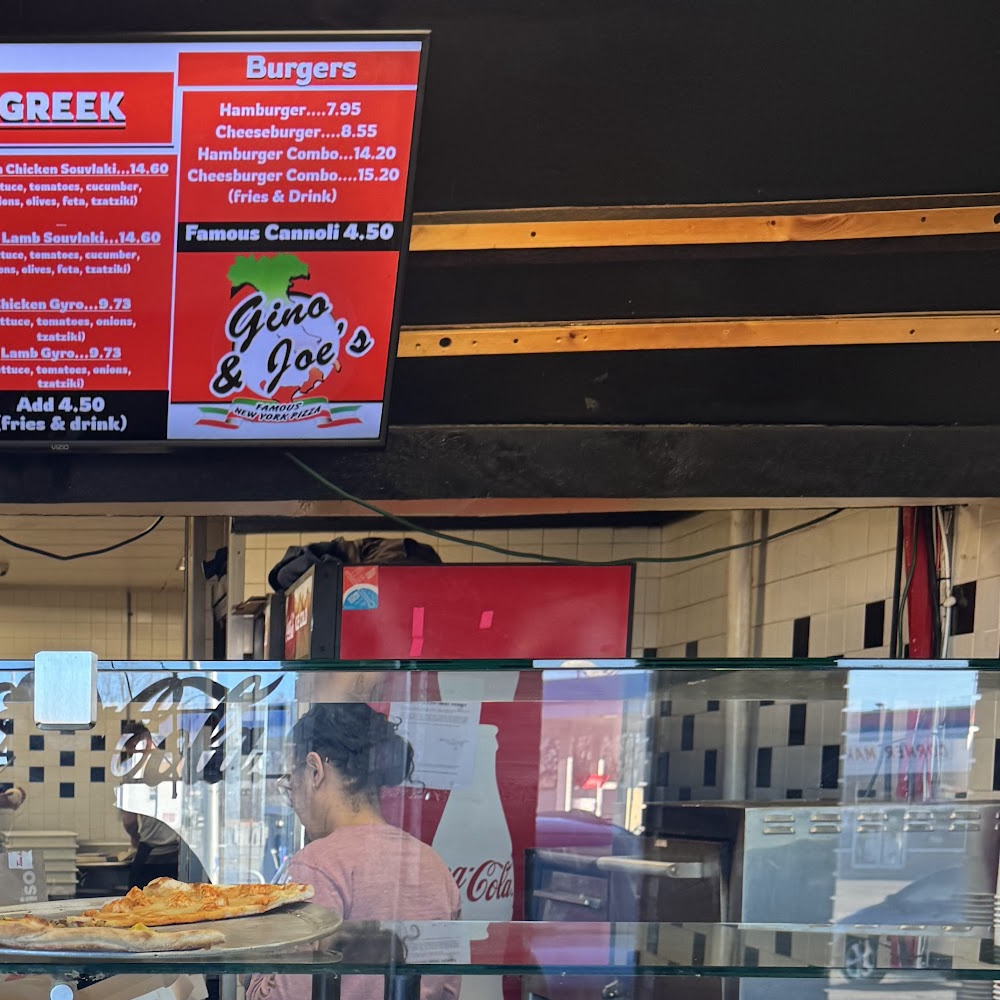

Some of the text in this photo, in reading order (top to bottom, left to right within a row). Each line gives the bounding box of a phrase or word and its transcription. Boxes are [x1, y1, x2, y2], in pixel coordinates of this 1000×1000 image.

[246, 55, 357, 86] Burgers
[198, 147, 283, 164] Hamburger
[6, 163, 58, 175] Chicken
[188, 169, 282, 186] Cheesburger
[29, 182, 83, 193] tomatoes,
[86, 181, 142, 193] cucumber,
[26, 196, 60, 207] olives,
[272, 190, 284, 203] &
[289, 188, 337, 204] Drink)
[2, 232, 40, 243] Lamb
[185, 223, 394, 240] Famous Cannoli 4.50
[228, 295, 329, 353] Gino
[1, 347, 38, 359] Lamb
[213, 355, 242, 394] &
[17, 397, 105, 413] Add 4.50
[255, 403, 302, 411] FAMOUS
[235, 406, 321, 421] NEW YORK PIZZA
[50, 417, 65, 431] &
[70, 415, 127, 432] drink)
[448, 859, 513, 902] a-Cola
